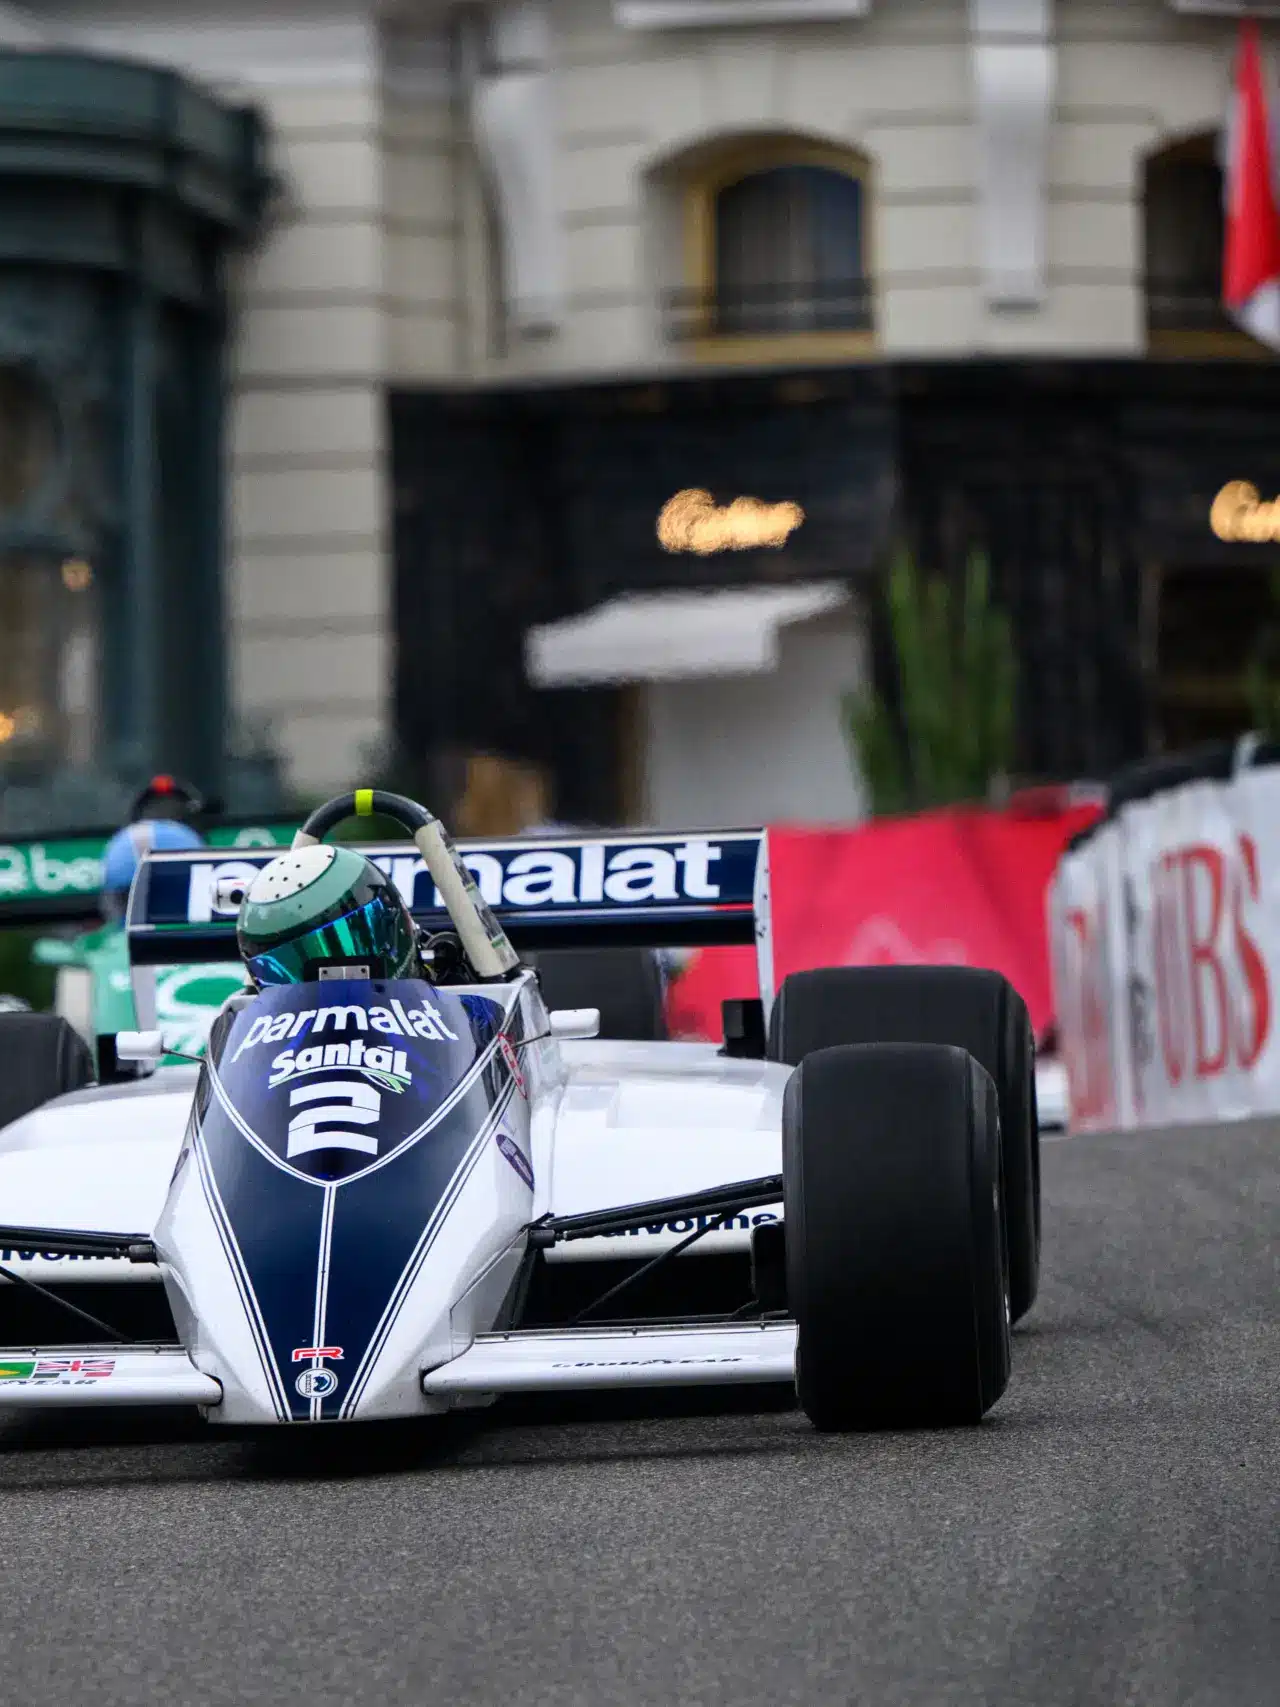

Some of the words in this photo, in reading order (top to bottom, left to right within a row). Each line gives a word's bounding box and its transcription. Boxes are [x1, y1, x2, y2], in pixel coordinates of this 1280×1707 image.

[188, 841, 720, 922] pmalat
[231, 999, 459, 1063] parmalat
[287, 1081, 381, 1158] 2
